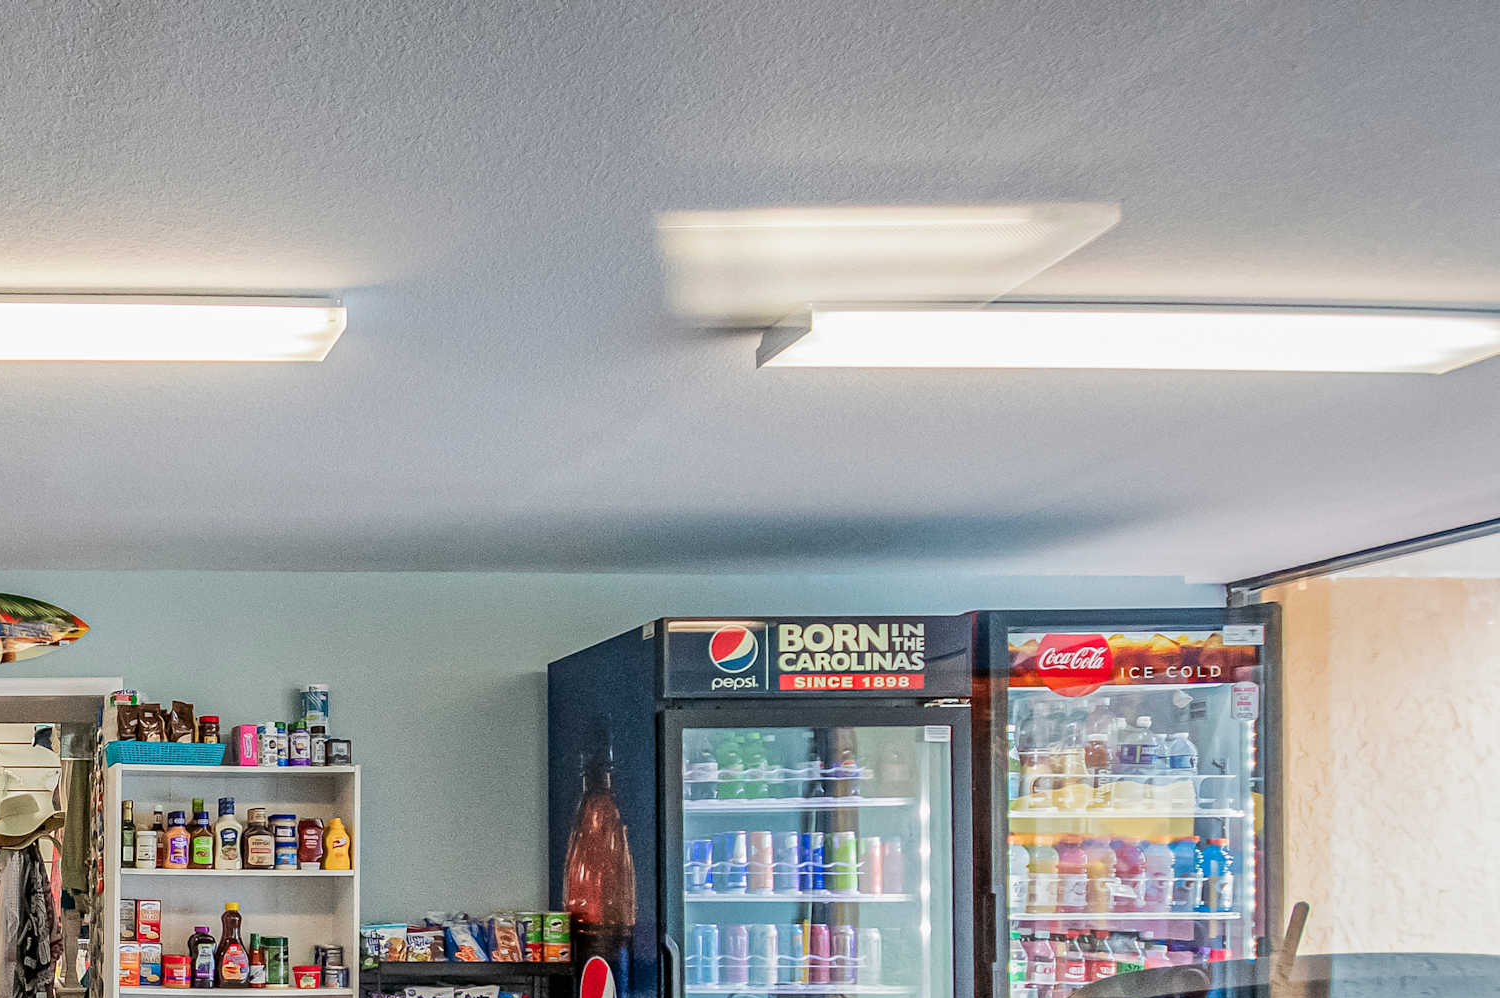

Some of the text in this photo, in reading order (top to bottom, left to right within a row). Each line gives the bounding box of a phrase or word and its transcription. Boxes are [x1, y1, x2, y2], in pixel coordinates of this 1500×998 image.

[779, 623, 925, 652] BORN IN
[892, 637, 925, 651] THE
[778, 652, 925, 672] CAROLINAS
[1120, 665, 1222, 679] ICE COLD
[711, 675, 758, 691] pepsi
[794, 676, 911, 688] SINCE 1898
